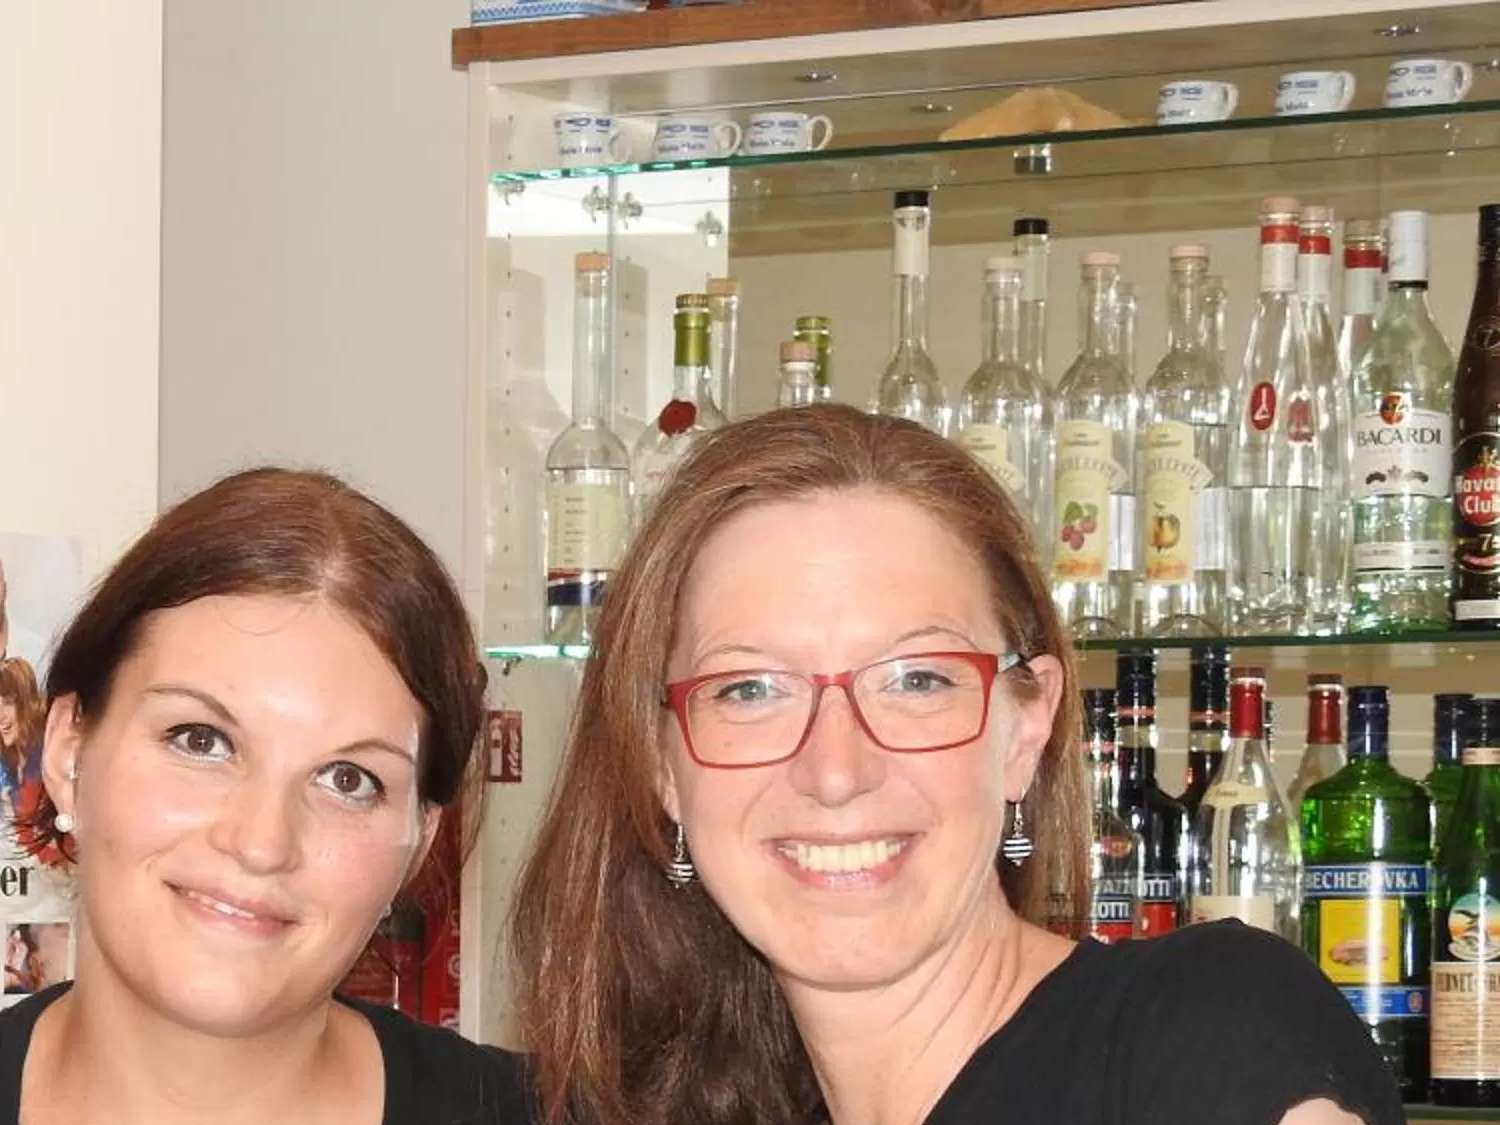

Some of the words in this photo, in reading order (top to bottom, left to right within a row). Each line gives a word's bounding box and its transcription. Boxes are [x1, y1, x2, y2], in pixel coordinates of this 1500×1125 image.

[1356, 427, 1443, 447] BACARDI
[1455, 475, 1500, 493] Hava
[1304, 871, 1419, 889] BECHERVKA
